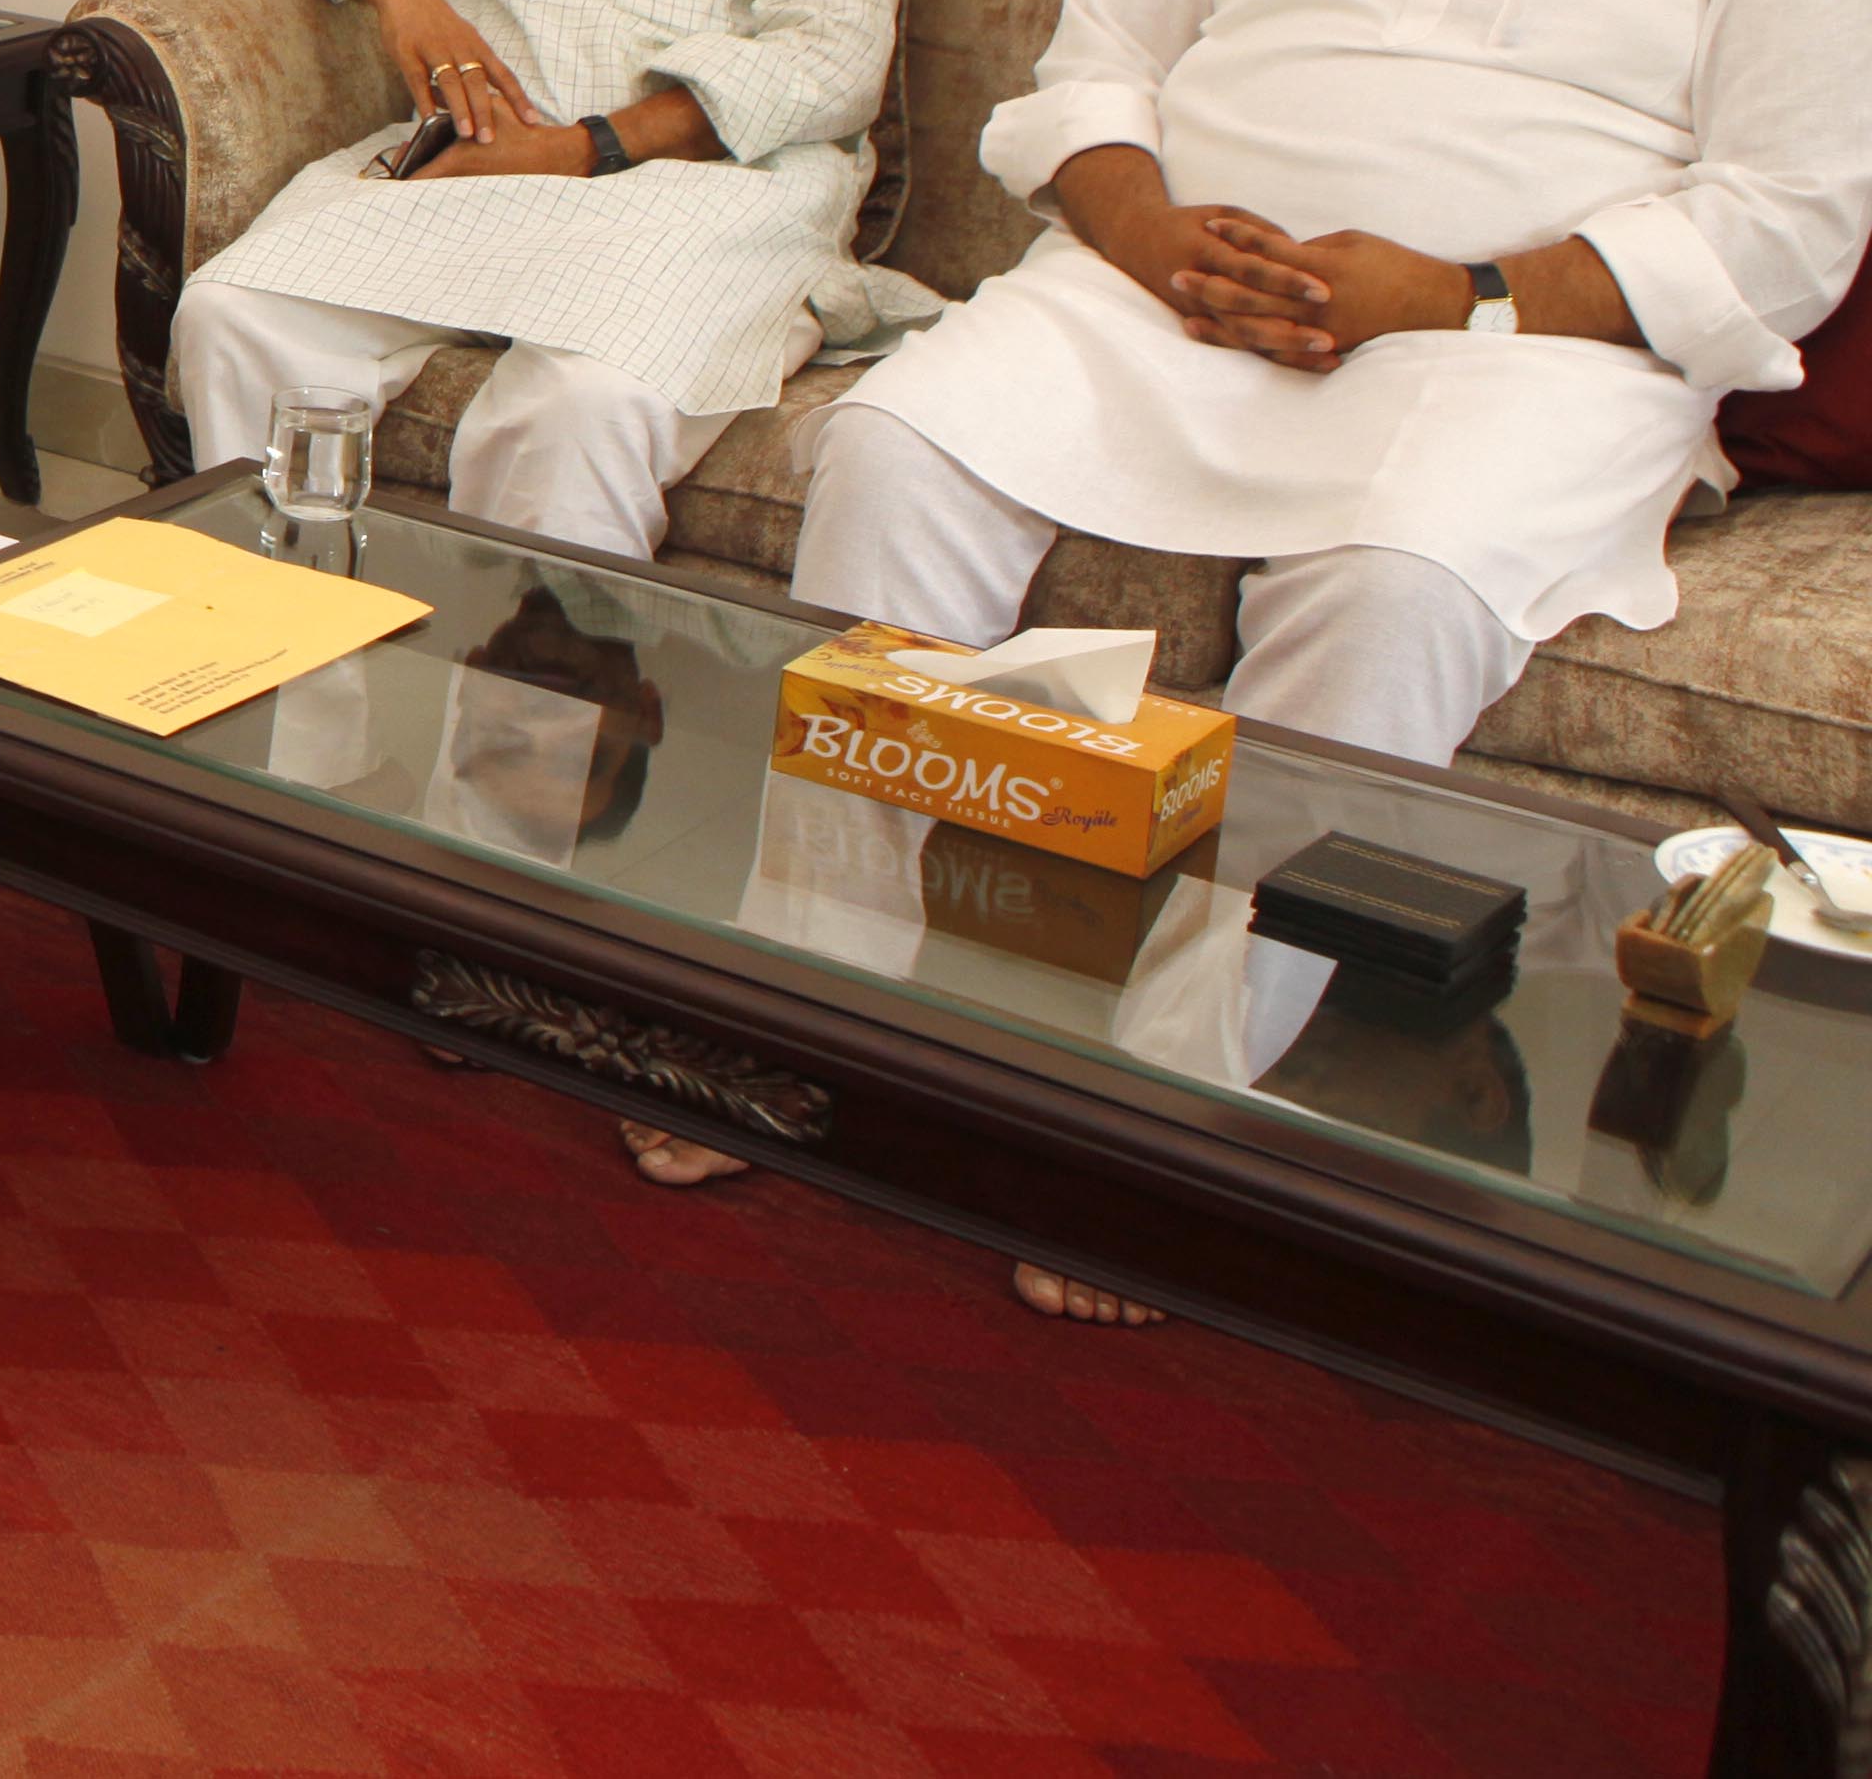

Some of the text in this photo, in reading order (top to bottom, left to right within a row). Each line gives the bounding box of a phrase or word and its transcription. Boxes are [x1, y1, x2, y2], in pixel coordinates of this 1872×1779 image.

[883, 674, 1144, 758] BLOOMS
[800, 713, 1050, 821] BLOOMS
[826, 767, 1011, 830] SOFT FACE TISSUE
[1159, 758, 1224, 823] BLOOMS
